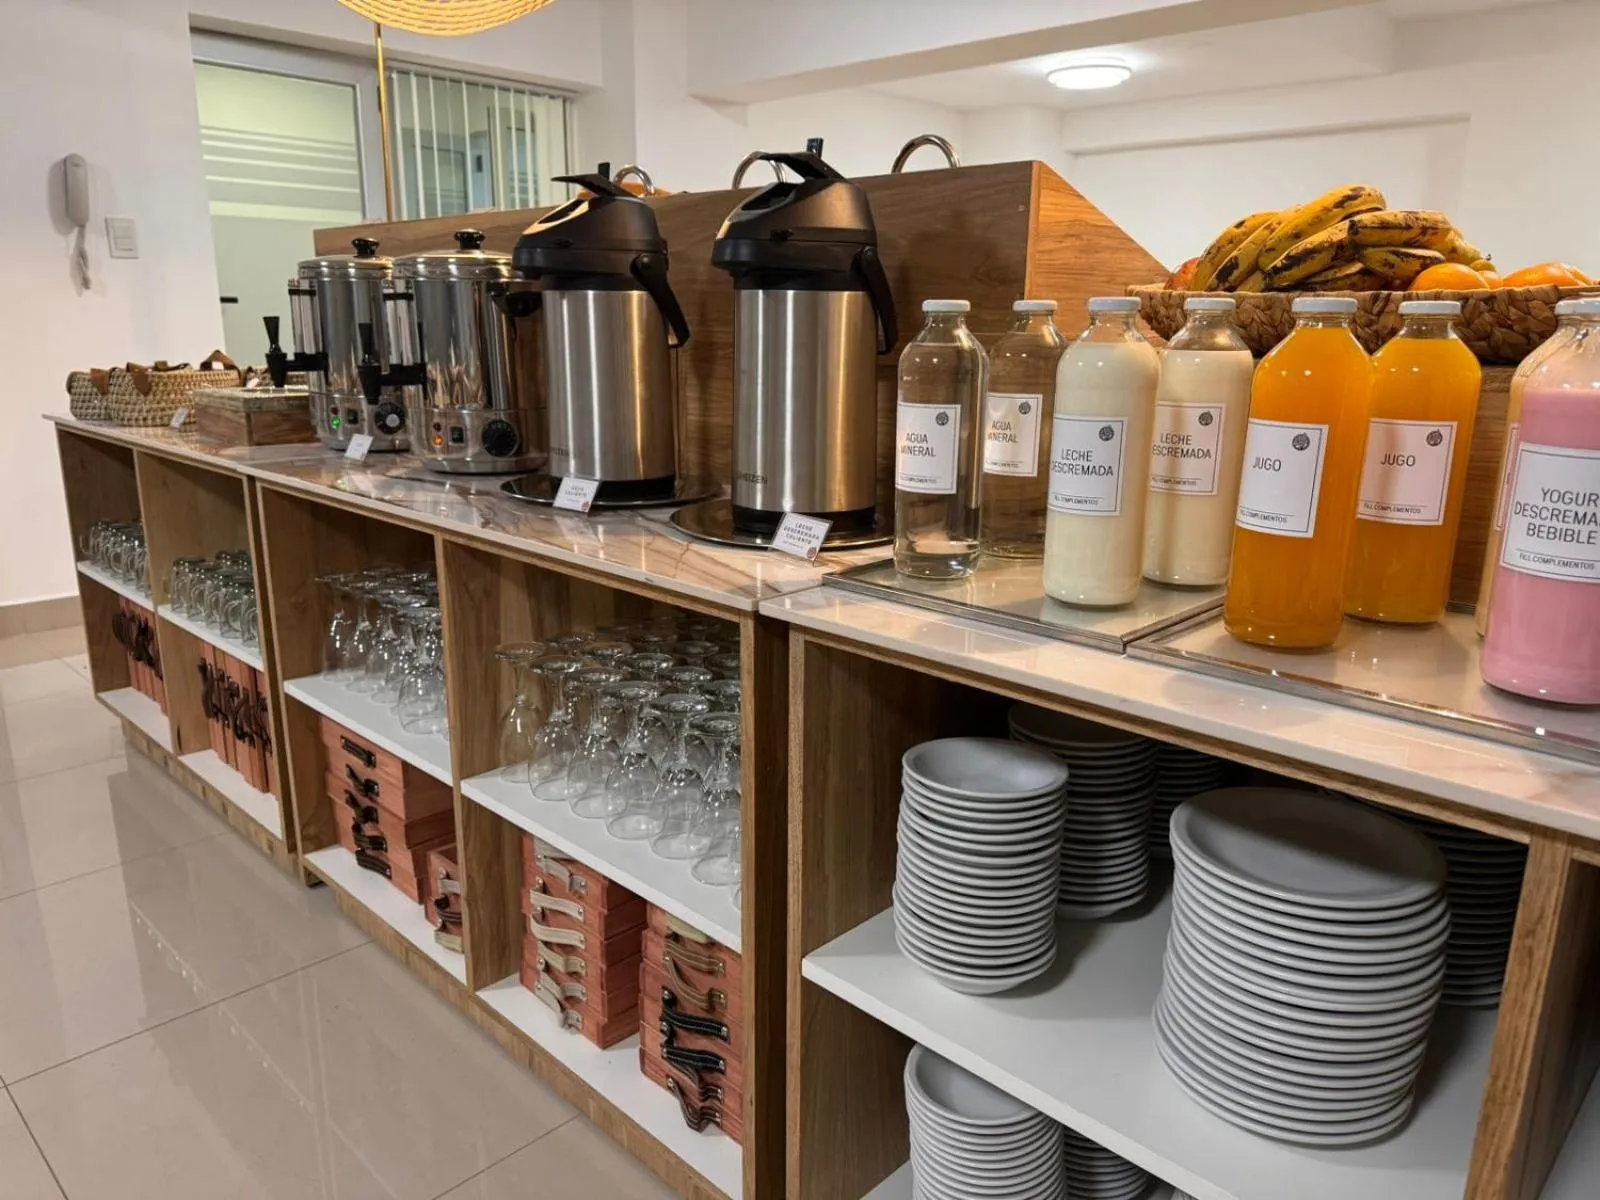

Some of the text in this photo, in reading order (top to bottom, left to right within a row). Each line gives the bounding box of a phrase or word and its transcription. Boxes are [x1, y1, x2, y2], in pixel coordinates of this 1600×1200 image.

[992, 420, 1012, 431] AGUA
[905, 432, 928, 444] AGUA
[1160, 433, 1192, 445] LECHE
[1061, 448, 1093, 462] LECHE
[1151, 444, 1212, 459] ESCREMADA
[1252, 456, 1282, 472] JUGO
[1380, 453, 1416, 467] JUGO
[1541, 487, 1600, 507] YOGUR
[1513, 501, 1600, 527] DESCREMA
[1526, 522, 1598, 545] BEBIBLE
